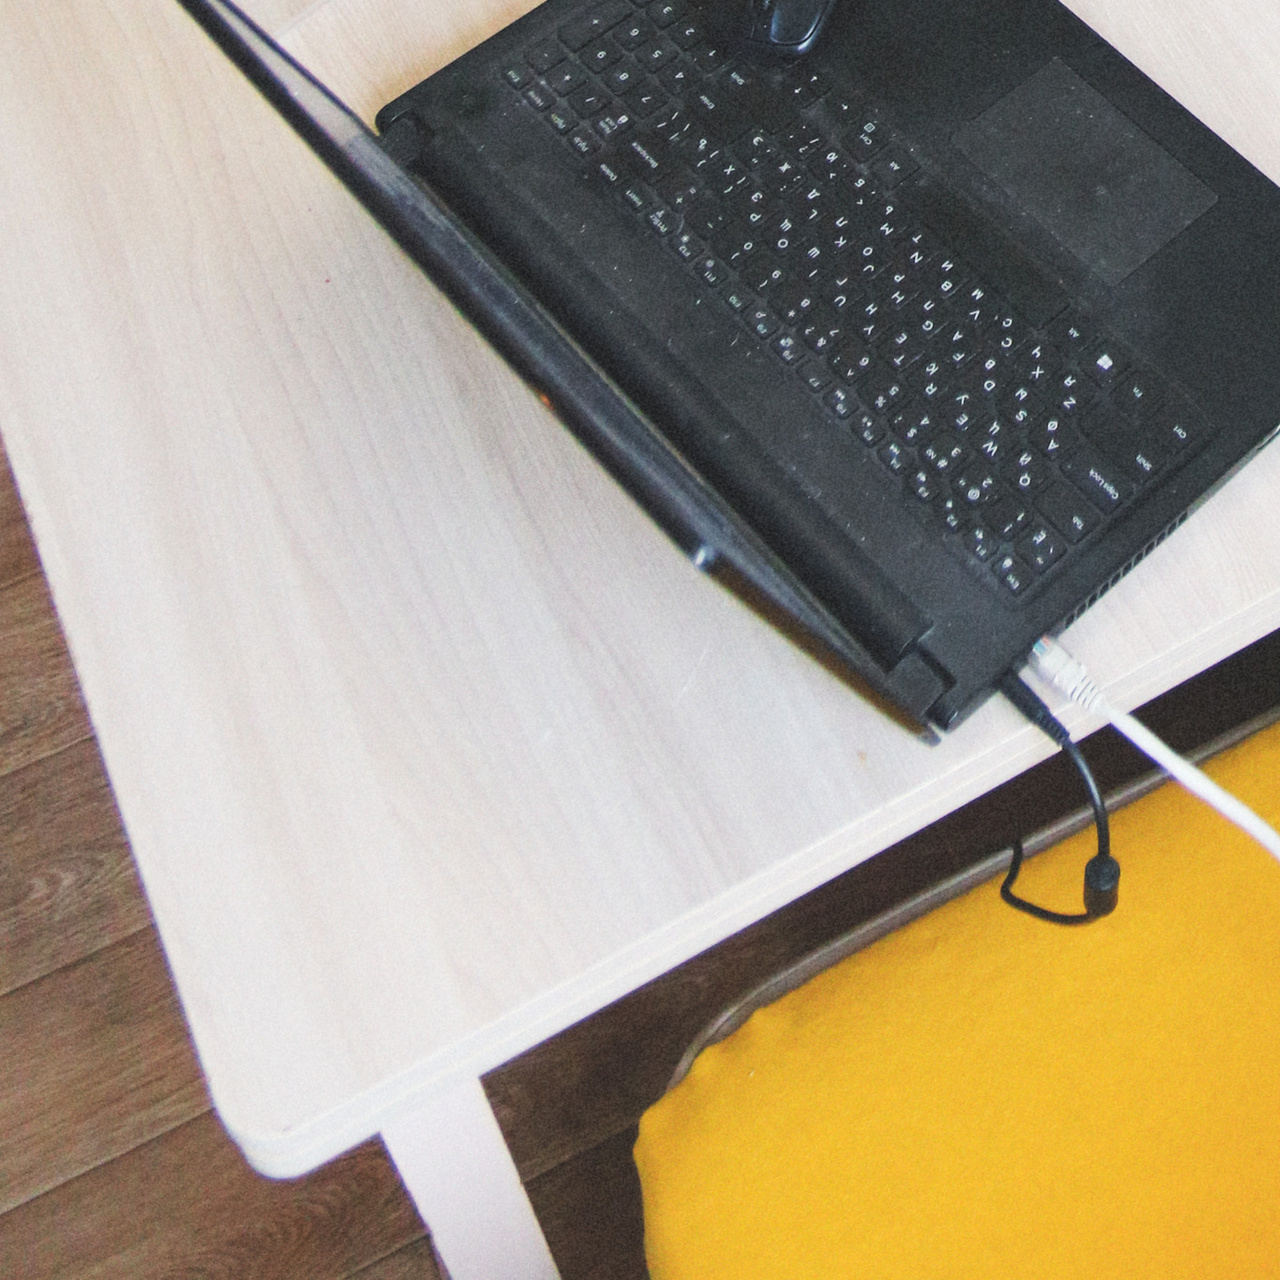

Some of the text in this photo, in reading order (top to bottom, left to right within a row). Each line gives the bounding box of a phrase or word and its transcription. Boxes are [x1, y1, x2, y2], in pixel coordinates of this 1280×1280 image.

[730, 71, 745, 84] Shift
[699, 94, 715, 109] Enter
[604, 116, 617, 129] Lock
[752, 136, 763, 145] Э
[859, 133, 872, 145] Ctrl
[631, 141, 658, 168] Backspace
[826, 151, 838, 162] Ю
[723, 164, 735, 174] Х
[778, 161, 791, 172] Ж
[889, 161, 900, 170] Alt
[599, 163, 617, 180] Delete
[854, 178, 865, 187] Б
[751, 191, 762, 202] З
[807, 188, 820, 199] Д
[808, 208, 817, 219] L
[885, 205, 893, 214] Ь
[749, 212, 761, 221] P
[835, 216, 848, 227] Л
[779, 218, 791, 231] Щ
[879, 222, 893, 235] M
[777, 237, 788, 248] O
[834, 235, 846, 247] K
[911, 234, 921, 243] Т
[807, 246, 820, 258] Ш
[862, 246, 873, 255] О
[909, 251, 923, 263] N
[941, 260, 953, 271] И
[808, 269, 817, 277] I
[893, 274, 905, 282] Р
[835, 277, 847, 285] Г
[940, 280, 952, 291] B
[891, 290, 904, 303] H
[971, 288, 983, 299] М
[833, 294, 846, 306] U
[923, 299, 934, 310] П
[865, 303, 877, 314] Н
[969, 309, 980, 320] V
[921, 319, 933, 330] G
[1002, 317, 1012, 327] С
[863, 324, 874, 335] Y
[952, 330, 963, 340] А
[1068, 327, 1079, 337] Alt
[895, 332, 907, 343] Е
[1000, 336, 1012, 347] C
[952, 352, 964, 361] F
[1031, 345, 1040, 357] Ч
[893, 354, 904, 365] T
[984, 358, 995, 369] В
[925, 362, 938, 375] К
[1031, 365, 1044, 378] X
[983, 379, 995, 391] D
[1063, 375, 1076, 386] Я
[925, 382, 937, 395] R
[1014, 387, 1027, 400] Ы
[1132, 386, 1142, 397] Fn
[955, 393, 969, 404] У
[1062, 396, 1076, 408] Z
[955, 413, 968, 425] E
[1015, 409, 1027, 421] S
[988, 420, 1000, 434] Ц
[1047, 420, 1058, 430] Ф
[1172, 425, 1186, 438] Ctrl
[982, 440, 997, 456] W
[1047, 438, 1059, 450] A
[1019, 452, 1031, 465] Й
[1135, 453, 1152, 470] Shift
[1018, 472, 1030, 486] Q
[1102, 481, 1118, 499] Caps
[1072, 515, 1083, 530] Tab
[1006, 574, 1019, 589] Esc
